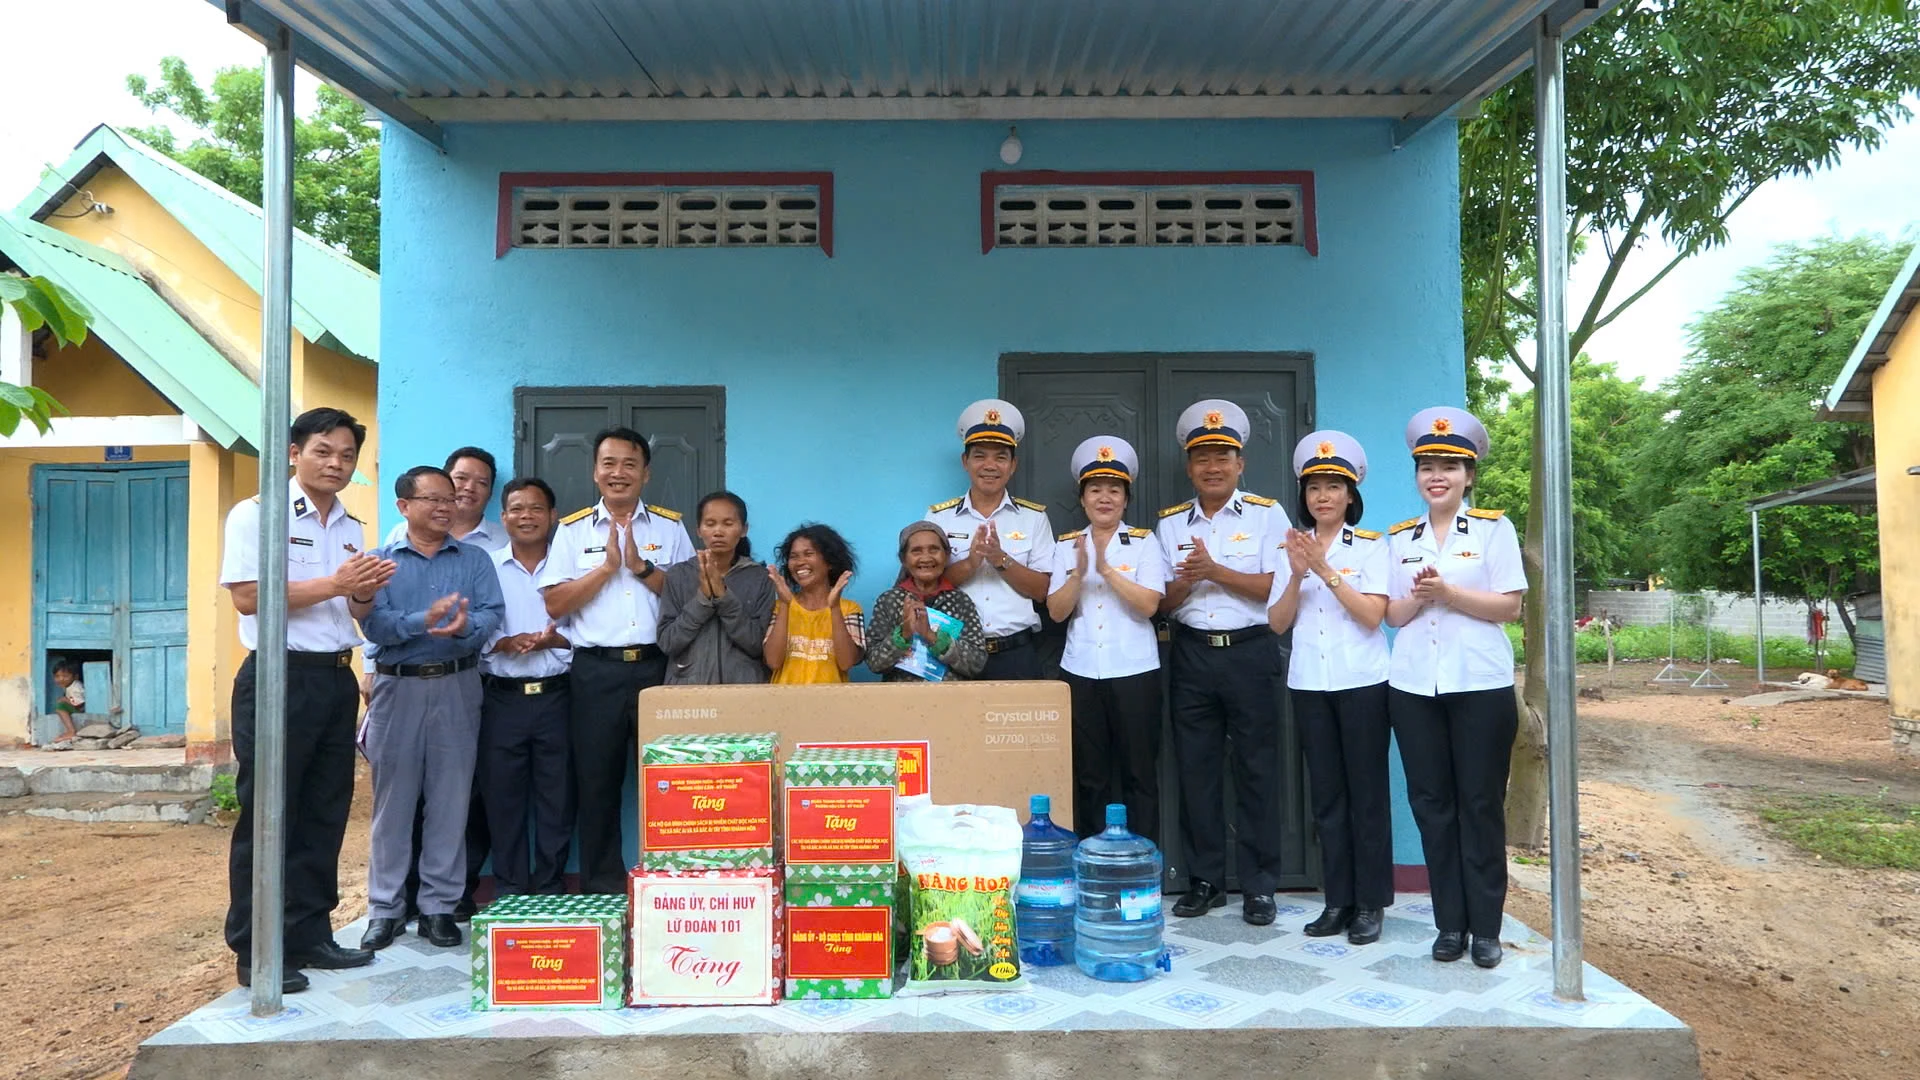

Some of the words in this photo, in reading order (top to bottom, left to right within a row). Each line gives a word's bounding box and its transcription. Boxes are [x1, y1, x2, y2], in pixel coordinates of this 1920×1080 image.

[655, 707, 718, 720] SAMSUNG
[985, 711, 1032, 726] Crystal
[1034, 710, 1060, 721] UHD
[985, 734, 1024, 744] DU7700
[898, 757, 917, 776] ỆNH
[692, 795, 726, 811] Tặng
[824, 814, 858, 831] Tặng
[917, 872, 968, 892] NÀNG
[974, 876, 1011, 892] HOA
[654, 892, 686, 910] ĐẢNG
[690, 892, 706, 912] ỦY,
[710, 892, 729, 910] CHỈ
[733, 896, 756, 910] HUY
[667, 918, 682, 932] LỮ
[684, 917, 717, 932] ĐOÀN
[722, 920, 741, 932] 101
[530, 955, 564, 971] Tặng
[662, 944, 743, 988] Tặng
